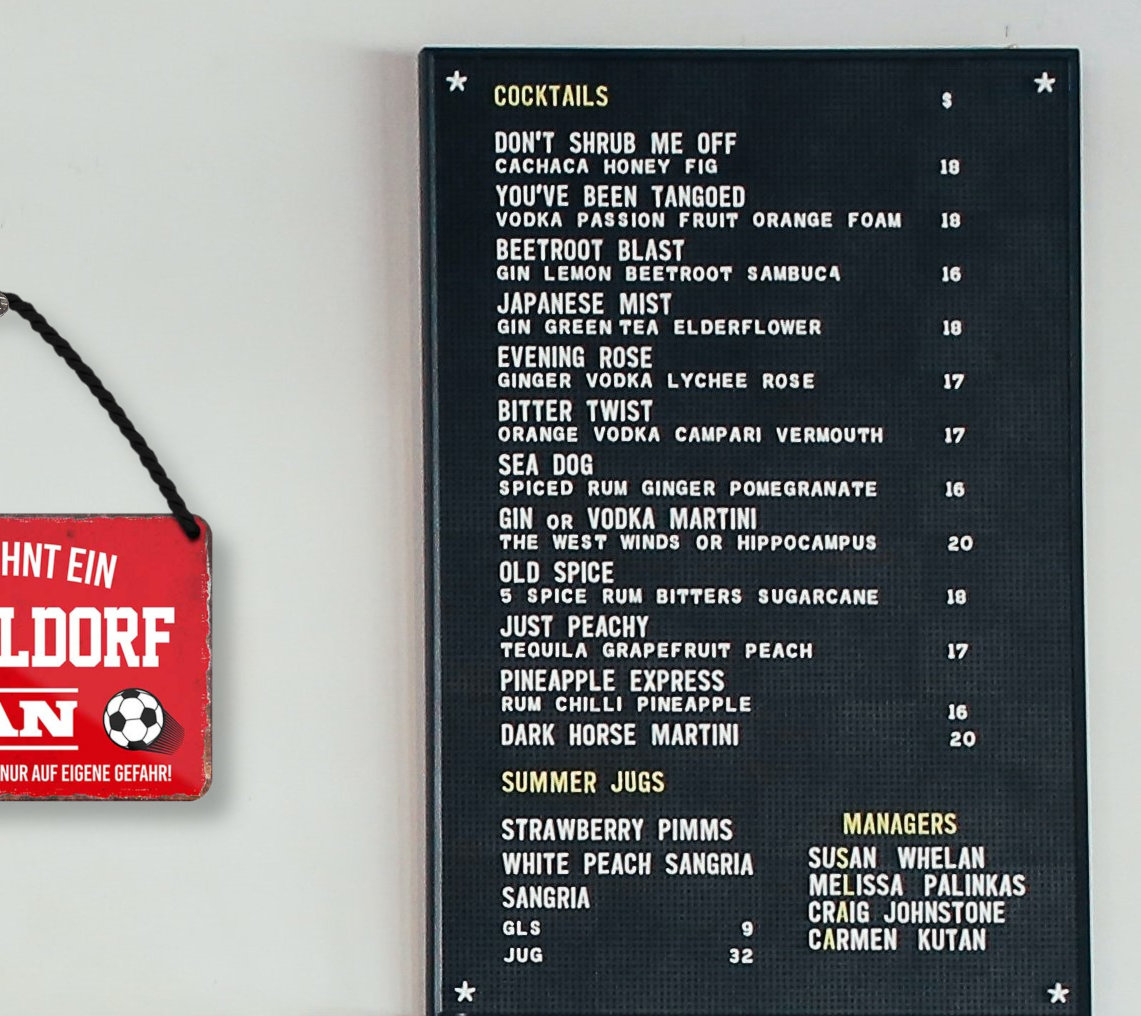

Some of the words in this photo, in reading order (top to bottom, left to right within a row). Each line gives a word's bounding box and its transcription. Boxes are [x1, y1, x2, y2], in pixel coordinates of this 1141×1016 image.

[494, 84, 609, 107] COCKTAILS
[942, 91, 953, 110] $
[494, 130, 555, 154] DON'T
[569, 131, 636, 155] SHRUB
[650, 131, 683, 155] ME
[697, 131, 737, 155] OFF
[495, 157, 589, 174] CACHACA
[603, 158, 671, 175] HONEY
[685, 158, 718, 175] FIG
[940, 158, 960, 175] 18
[495, 183, 569, 208] YOU'VE
[583, 184, 637, 208] BEEN
[650, 184, 746, 209] TANGOED
[495, 211, 563, 228] VODKA
[577, 211, 665, 228] PASSION
[679, 211, 739, 228] FRUIT
[752, 211, 833, 228] ORANGE
[848, 211, 902, 229] FOAM
[941, 212, 961, 229] 18
[496, 238, 604, 262] BEETROOT
[618, 238, 685, 262] BLAST
[496, 265, 530, 282] GIN
[544, 265, 612, 282] LEMON
[625, 265, 733, 282] BEETROOT
[747, 265, 841, 282] SAMBUCA
[941, 266, 962, 283] 16
[496, 291, 604, 315] JAPANESE
[619, 292, 672, 316] MIST
[497, 318, 531, 335] GIN
[544, 318, 612, 336] GREEN
[618, 319, 659, 336] TEA
[673, 319, 822, 336] ELDERFLOWER
[943, 319, 962, 336] 18
[497, 345, 585, 369] EVENING
[599, 345, 653, 370] ROSE
[497, 372, 572, 389] GINGER
[585, 372, 653, 389] VODKA
[667, 372, 748, 389] LYCHEE
[762, 372, 815, 390] ROSE
[943, 373, 965, 390] 17
[498, 399, 573, 423] BITTER
[585, 399, 653, 423] TWIST
[497, 425, 578, 443] ORANGE
[593, 426, 661, 443] VODKA
[675, 426, 762, 443] CAMPARI
[776, 426, 884, 444] VERMOUTH
[944, 427, 966, 444] 17
[498, 453, 539, 476] SEA
[552, 453, 594, 476] DOG
[499, 479, 574, 497] SPICED
[587, 480, 628, 497] RUM
[641, 479, 716, 497] GINGER
[729, 480, 878, 498] POMEGRANATE
[945, 481, 965, 498] 16
[499, 506, 533, 530] GIN
[546, 513, 574, 531] OR
[587, 506, 656, 530] VODKA
[669, 506, 757, 531] MARTINI
[499, 533, 539, 550] THE
[552, 533, 608, 551] WEST
[619, 533, 680, 550] WINDS
[695, 534, 723, 551] OR
[737, 534, 877, 552] HIPPOCAMPUS
[947, 535, 974, 552] 20
[66, 548, 118, 589] EIN
[499, 560, 540, 584] OLD
[553, 560, 614, 584] SPICE
[499, 587, 512, 604] 5
[527, 587, 587, 605] SPICE
[602, 587, 643, 605] RUM
[656, 587, 742, 605] BITTERS
[758, 588, 879, 606] SUGARCANE
[947, 588, 967, 605] 18
[499, 614, 554, 638] JUST
[568, 614, 649, 638] PEACHY
[500, 641, 588, 659] TEQUILA
[602, 641, 731, 659] GRAPEFRUIT
[745, 642, 813, 659] PEACH
[947, 643, 969, 660] 17
[500, 668, 616, 692] PINEAPPLE
[630, 669, 725, 693] EXPRESS
[501, 695, 542, 712] RUM
[555, 696, 622, 713] CHILLI
[637, 695, 752, 713] PINEAPPLE
[948, 703, 968, 721] 16
[501, 723, 555, 746] DARK
[569, 722, 637, 747] HORSE
[651, 722, 739, 747] MARTINI
[949, 730, 977, 748] 20
[0, 764, 28, 782] NUR
[31, 764, 58, 782] AUF
[61, 764, 111, 782] EIGENE
[114, 764, 172, 782] GEFAHR!
[501, 770, 597, 794] SUMMER
[610, 770, 665, 793] JUGS
[501, 817, 644, 842] STRAWBERRY
[658, 818, 733, 842] PIMMS
[843, 812, 958, 836] MANAGERS
[502, 851, 570, 876] WHITE
[583, 851, 652, 876] PEACH
[665, 852, 754, 876] SANGRIA
[808, 846, 877, 870] SUSAN
[897, 846, 985, 870] WHELAN
[809, 873, 904, 897] MELISSA
[924, 873, 1027, 897] PALINKAS
[502, 885, 591, 910] SANGRIA
[808, 900, 870, 924] CRAIG
[883, 900, 1006, 924] JOHNSTONE
[502, 920, 541, 936] GLS
[741, 920, 754, 937] 9
[808, 927, 898, 951] CARMEN
[918, 927, 986, 952] KUTAN
[503, 947, 543, 963] JUG
[729, 947, 754, 964] 32
